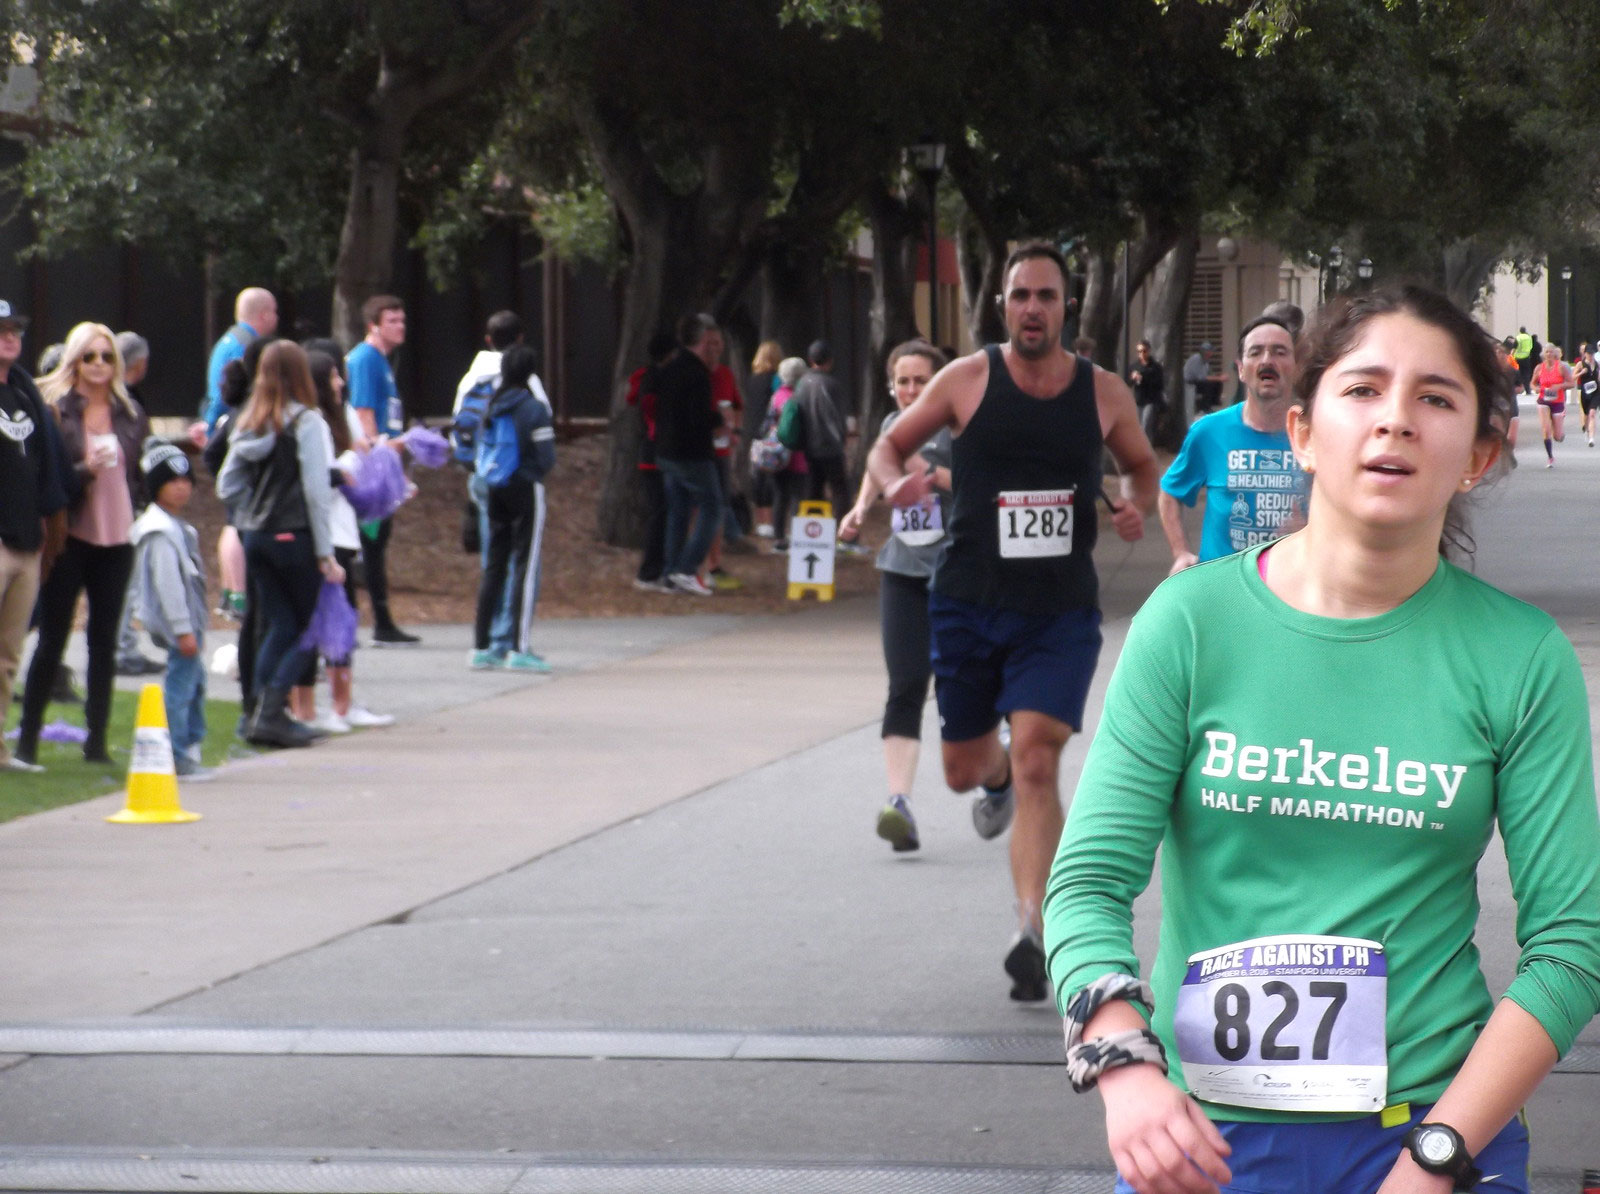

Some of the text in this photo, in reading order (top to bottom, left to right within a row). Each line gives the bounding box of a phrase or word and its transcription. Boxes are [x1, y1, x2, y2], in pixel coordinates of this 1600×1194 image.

[1228, 450, 1257, 470] GET
[1238, 474, 1292, 488] HEALTHIER
[901, 508, 932, 531] 582
[1008, 507, 1069, 538] 1282
[1201, 730, 1468, 809] Berkeley
[1201, 788, 1262, 813] HALF
[1270, 797, 1425, 829] MARATHON
[1200, 944, 1370, 977] RACE AGAINST PH
[1200, 969, 1240, 984] NOVEMBER
[1249, 968, 1269, 976] 2016
[1275, 967, 1319, 976] STANFORD
[1320, 968, 1367, 976] UNIVERSITY
[1214, 980, 1347, 1062] 827
